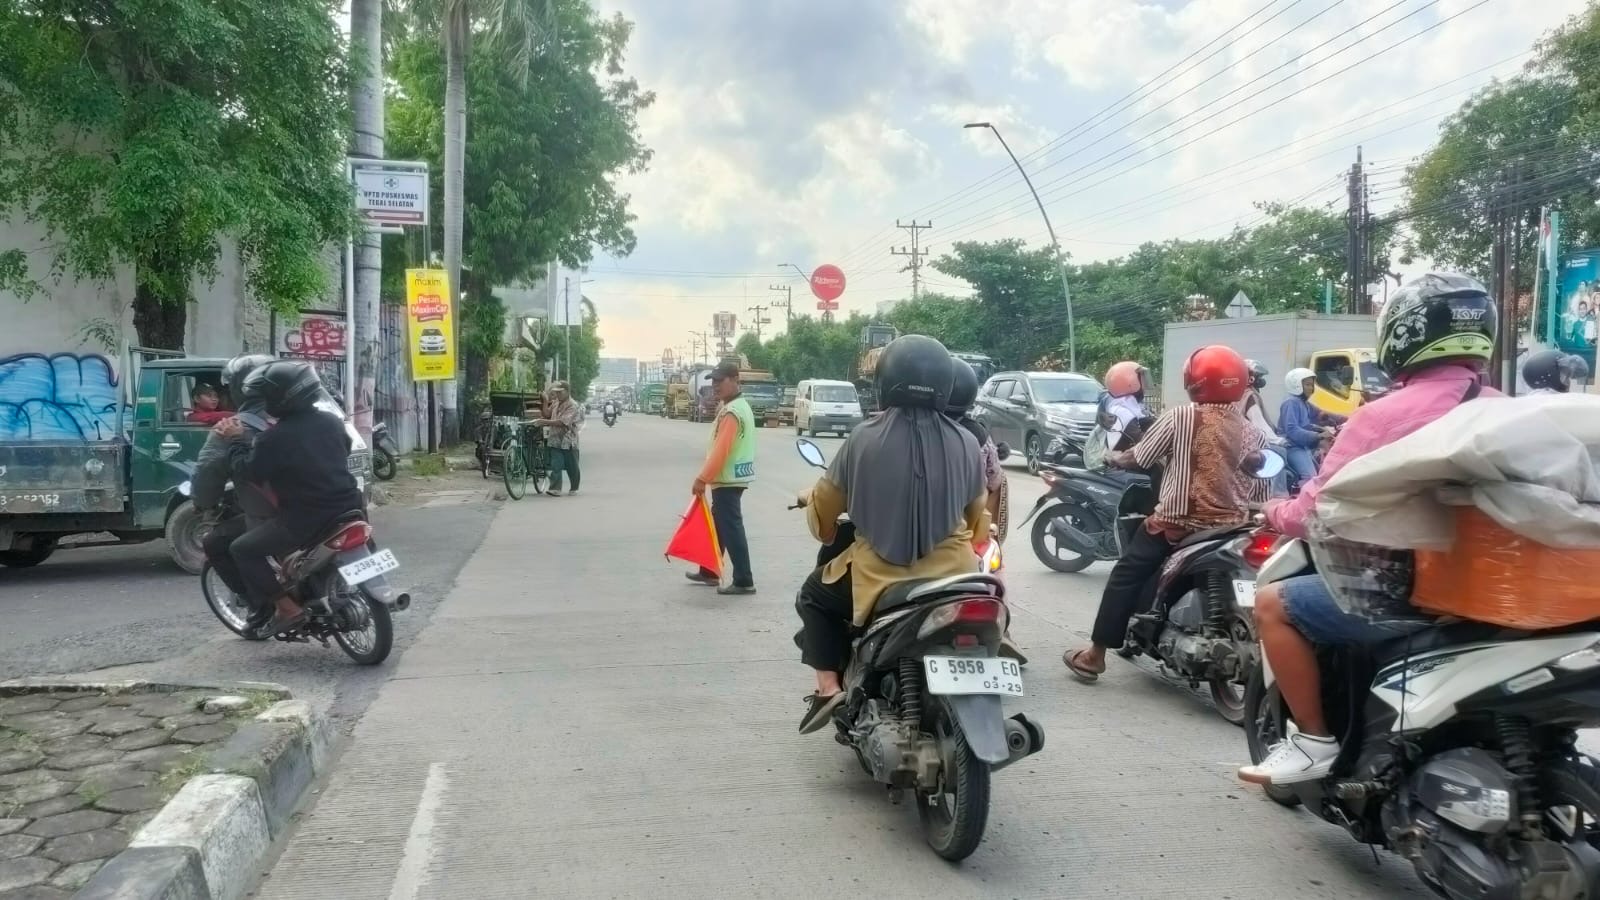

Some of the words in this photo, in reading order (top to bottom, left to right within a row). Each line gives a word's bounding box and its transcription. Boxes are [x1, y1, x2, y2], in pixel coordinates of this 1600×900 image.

[381, 191, 419, 201] PUSKESMAS
[368, 199, 387, 207] TEGAL
[387, 200, 414, 208] SELATAN
[414, 278, 442, 286] maxim
[418, 295, 440, 304] Pesan
[411, 304, 448, 314] MaximCar
[1451, 308, 1486, 320] KYT
[1236, 582, 1245, 593] G
[929, 659, 938, 674] G
[947, 659, 986, 674] 5958
